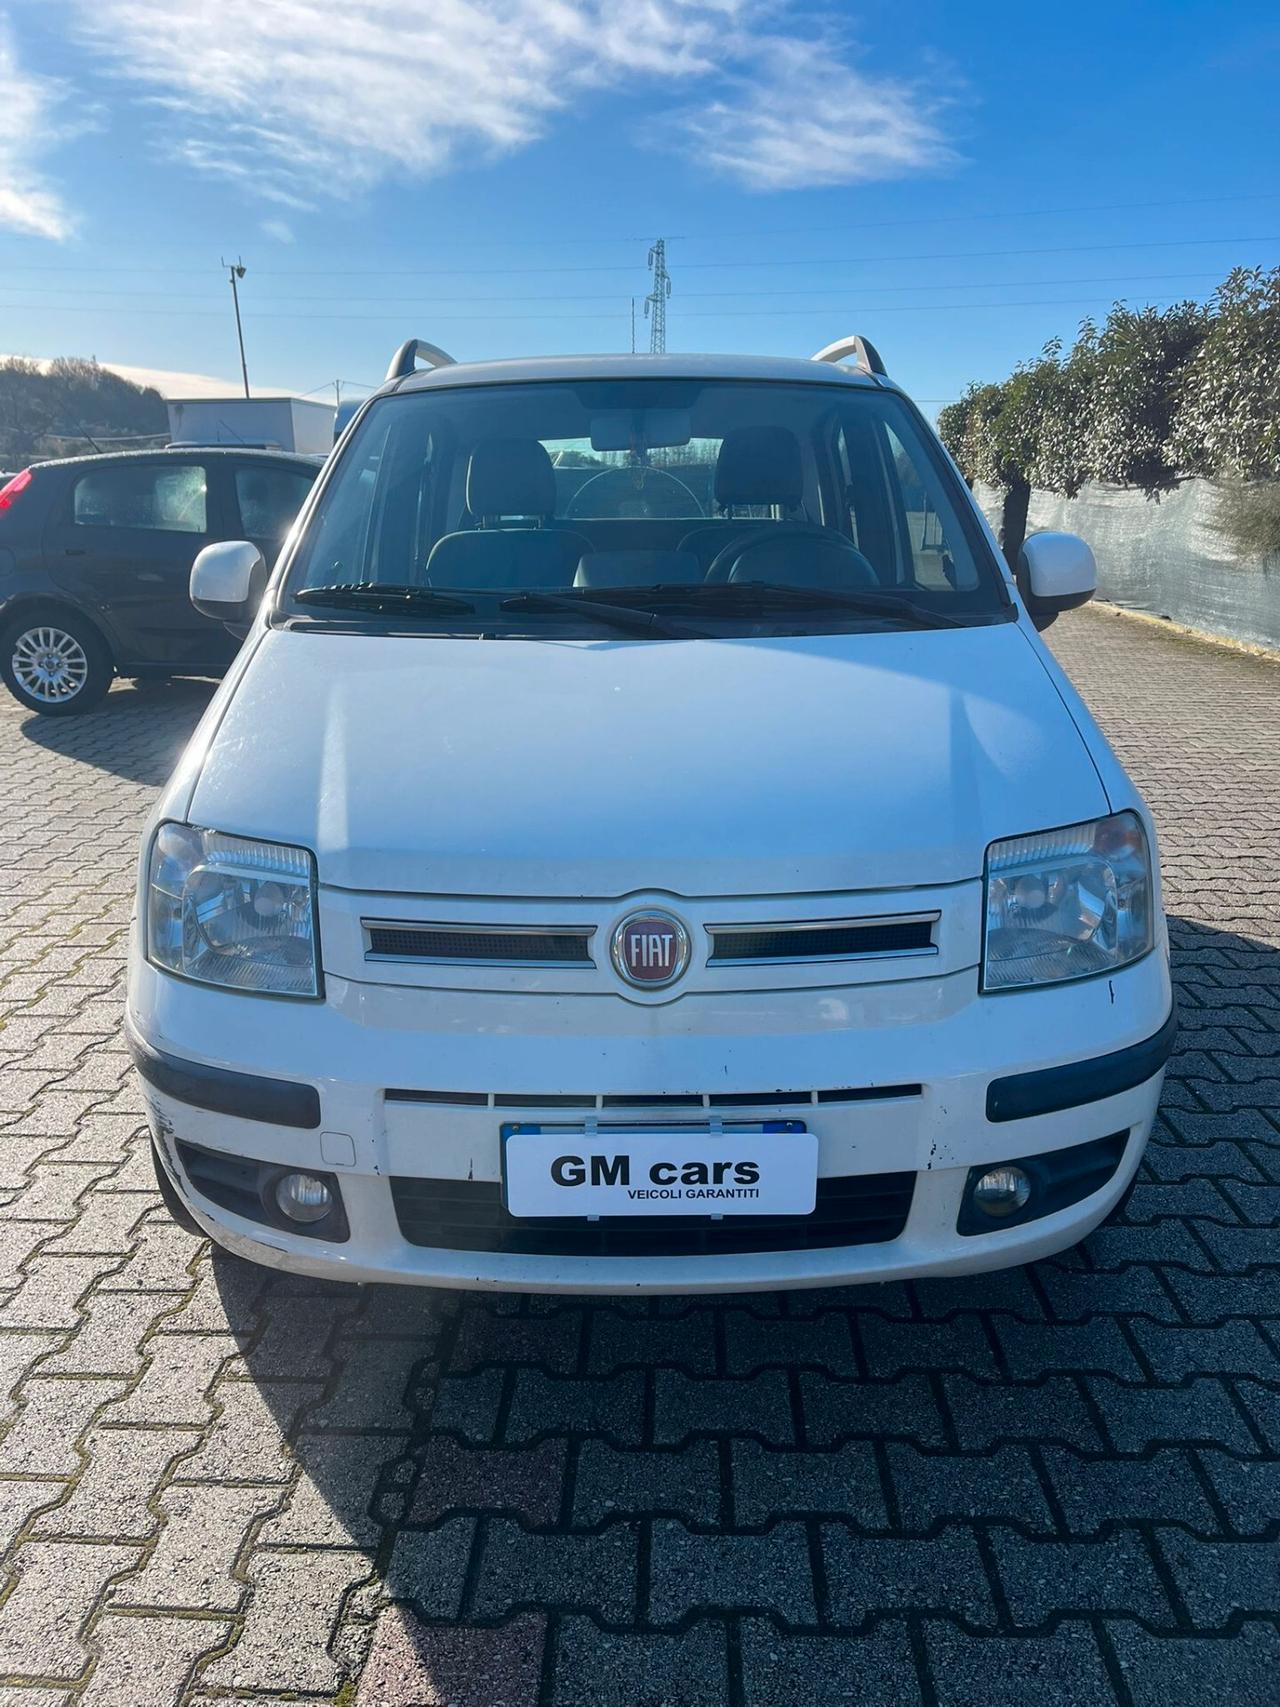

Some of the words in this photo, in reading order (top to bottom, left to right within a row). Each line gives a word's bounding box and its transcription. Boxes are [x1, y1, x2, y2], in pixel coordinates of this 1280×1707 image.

[630, 934, 673, 967] FIAT
[550, 1155, 630, 1187] GM
[649, 1160, 760, 1185] cars
[627, 1189, 682, 1199] VEICOLI
[686, 1188, 759, 1199] GARANTITI
